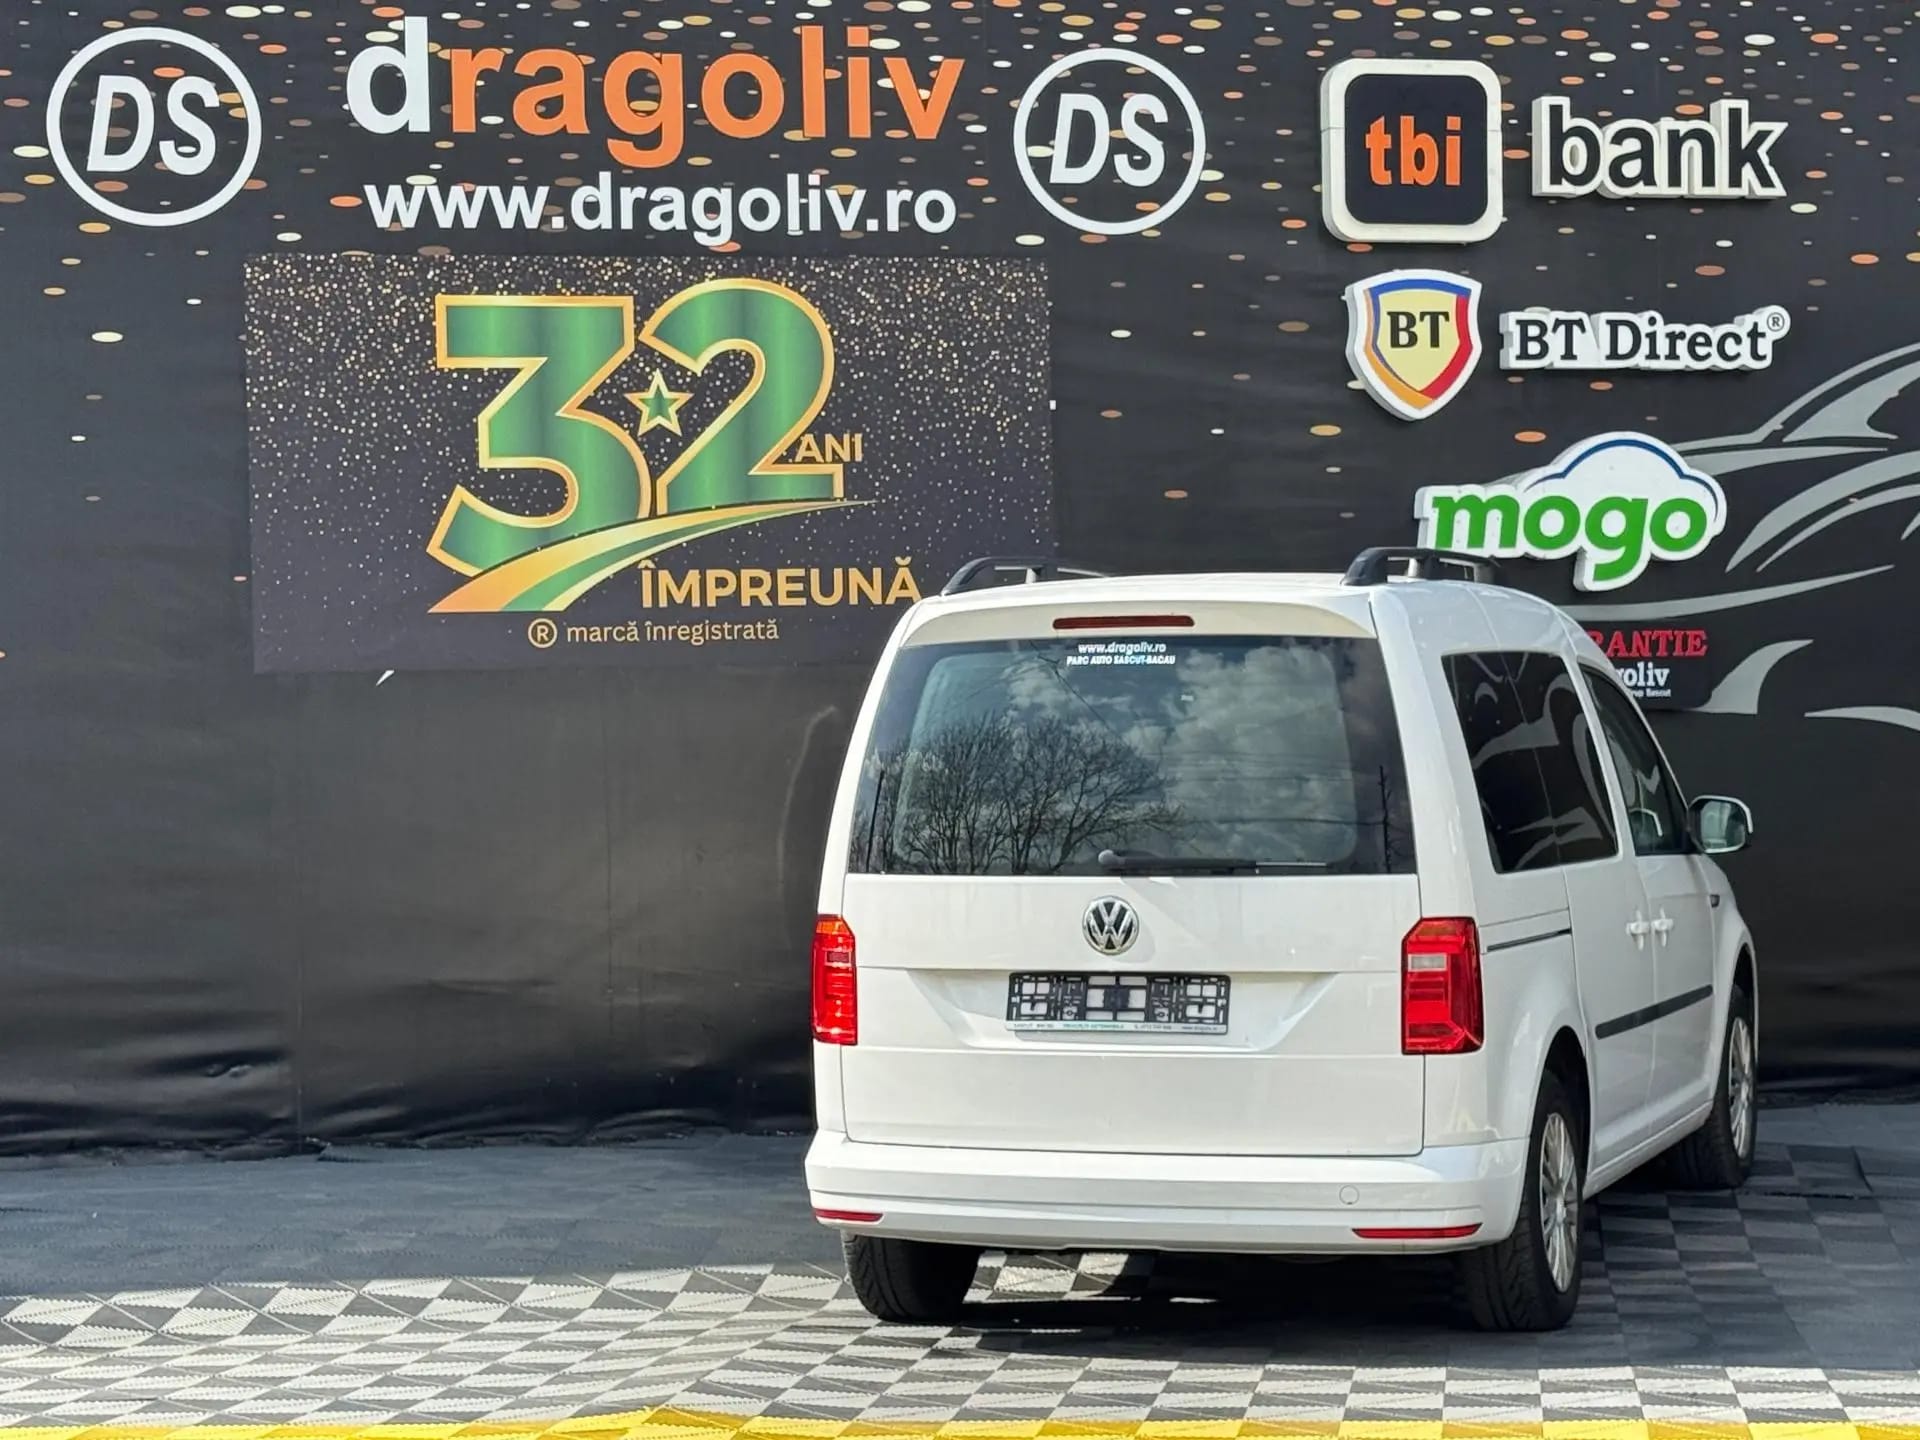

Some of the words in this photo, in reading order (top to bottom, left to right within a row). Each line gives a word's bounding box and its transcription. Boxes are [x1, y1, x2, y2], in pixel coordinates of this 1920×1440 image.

[87, 74, 221, 176] DS
[346, 16, 965, 169] dragoliv
[1048, 92, 1169, 187] DS
[1365, 115, 1463, 186] tbi
[1548, 103, 1784, 189] bank
[364, 171, 957, 248] www.dragoliv.ro
[1387, 310, 1450, 348] BT
[1515, 318, 1585, 361] BT
[427, 278, 835, 577] 32
[794, 432, 863, 463] ANI
[1432, 494, 1707, 582] mogo
[640, 557, 921, 609] ÎMPREUNĂ
[567, 621, 639, 643] marcă
[646, 619, 779, 646] înregistrată
[1078, 641, 1167, 655] www.dragoliv.ro
[1090, 655, 1113, 665] AUTO
